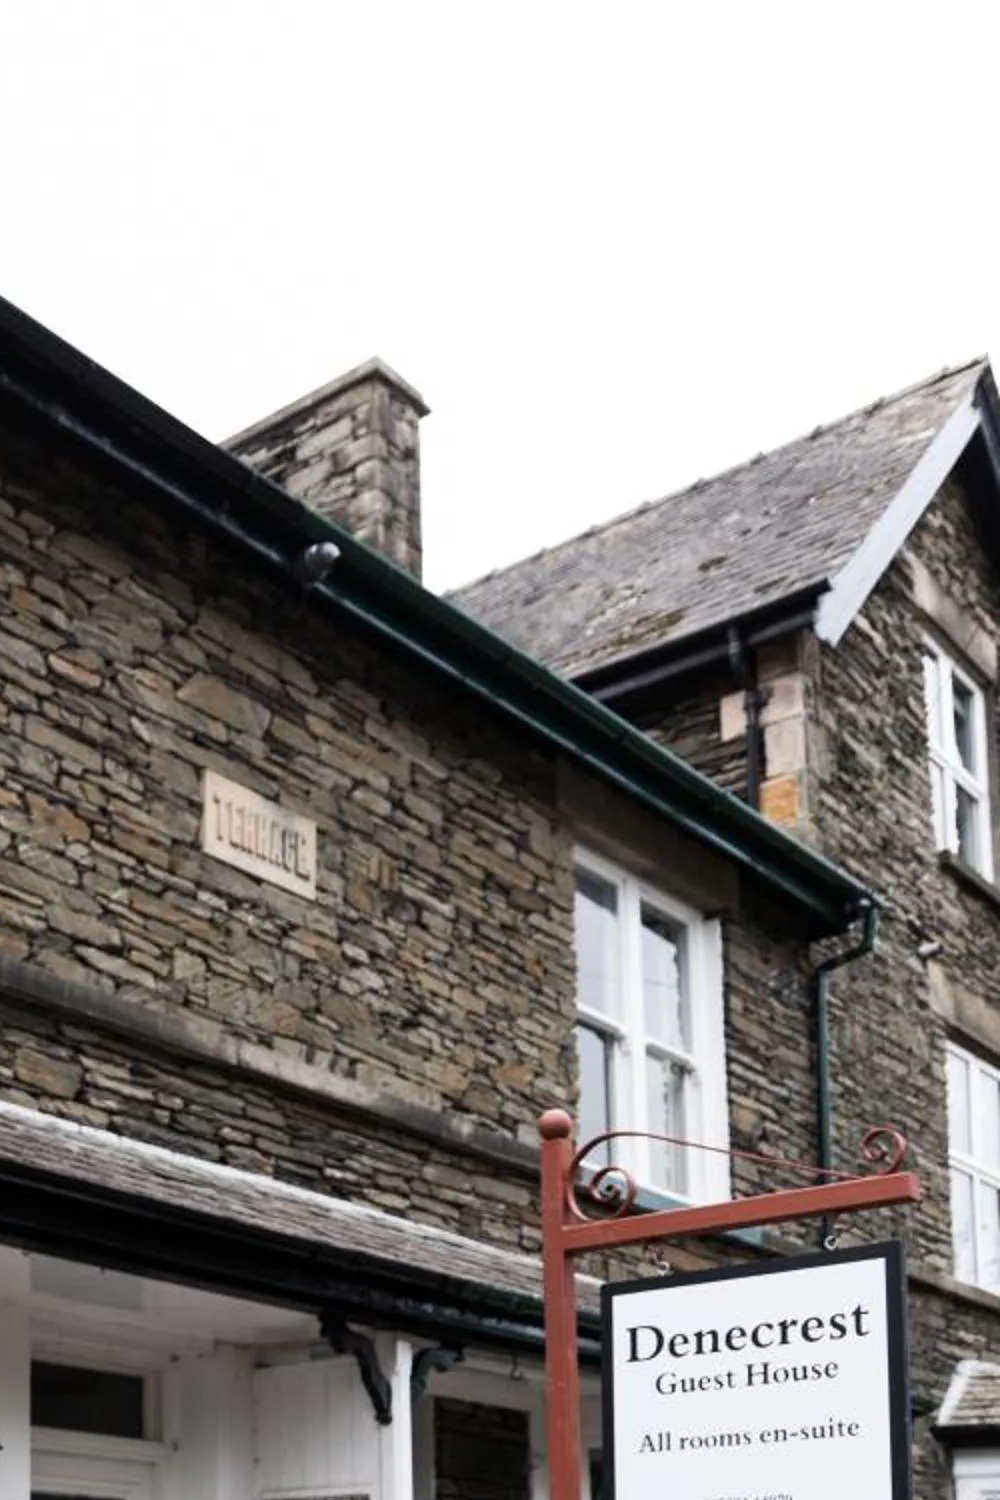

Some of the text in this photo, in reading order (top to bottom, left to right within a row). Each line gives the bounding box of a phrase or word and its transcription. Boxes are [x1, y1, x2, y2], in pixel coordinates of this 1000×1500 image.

[626, 1304, 870, 1362] Denecrest
[655, 1361, 840, 1395] Guest House
[639, 1417, 861, 1453] All rooms en-suite
